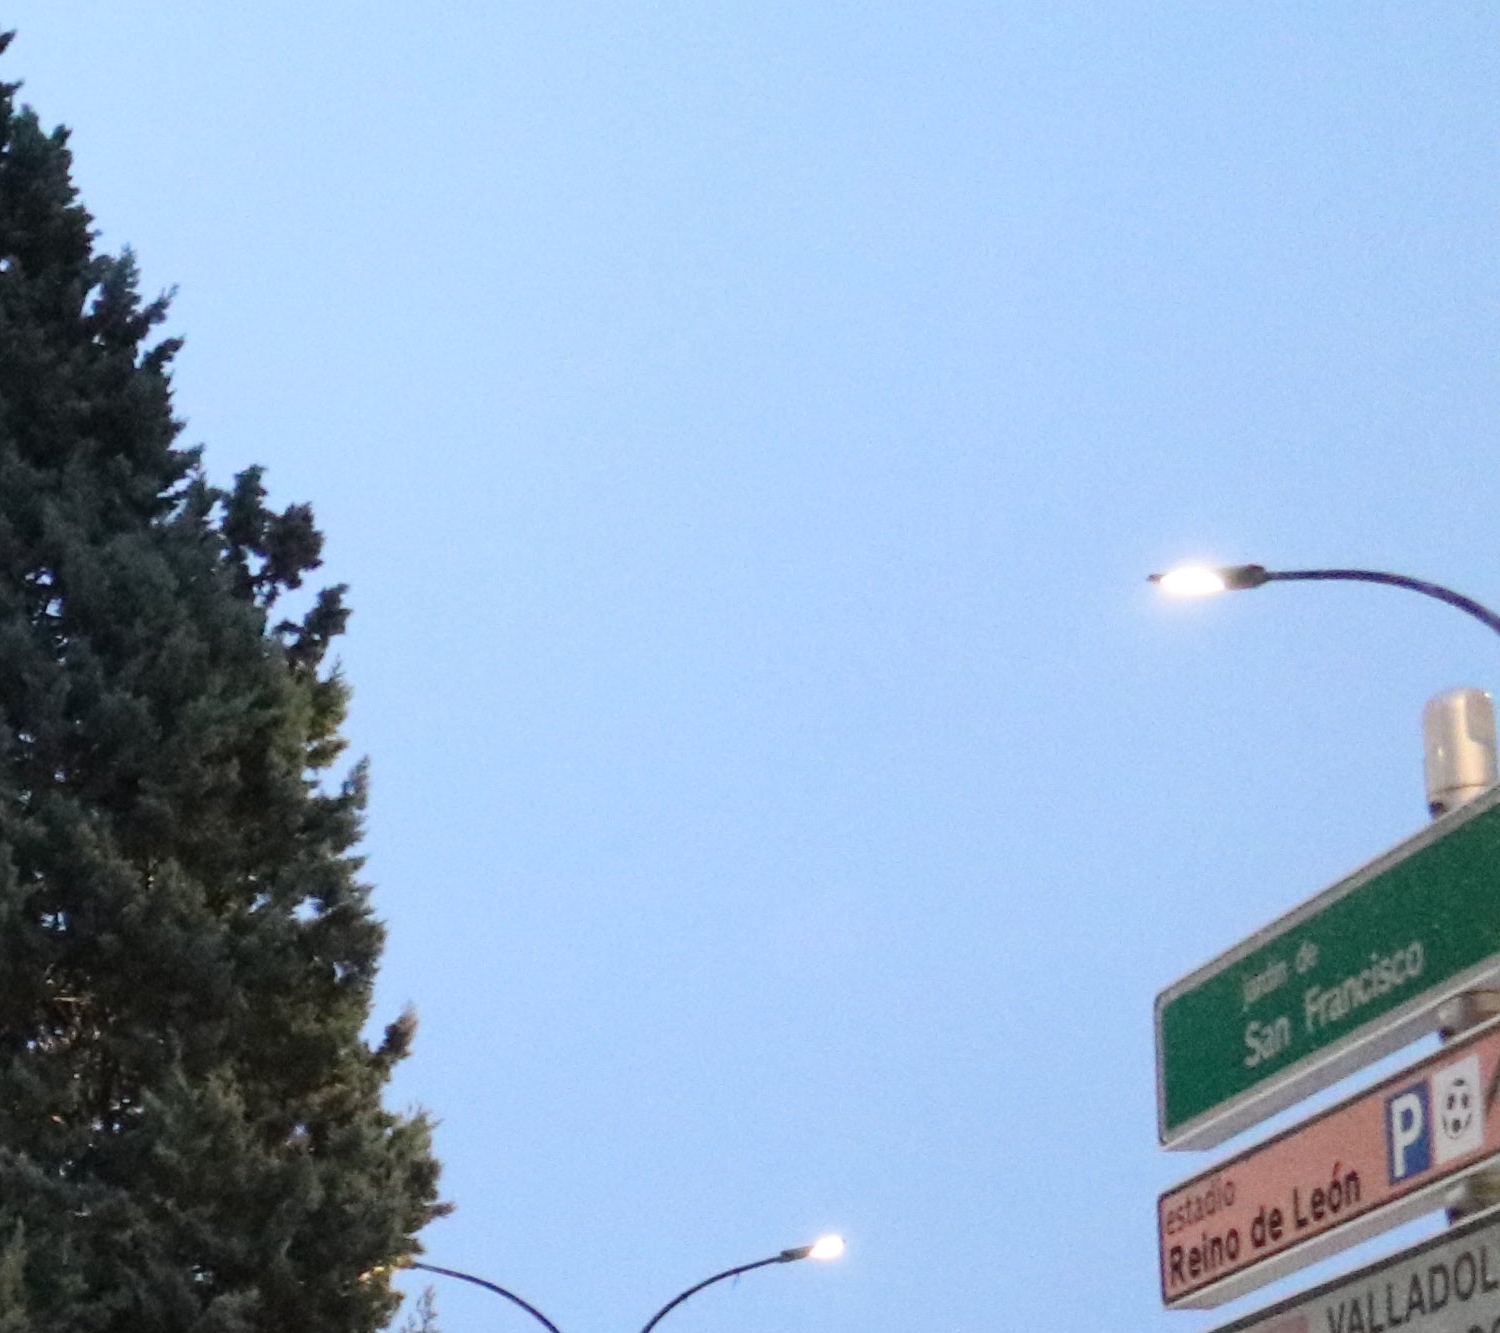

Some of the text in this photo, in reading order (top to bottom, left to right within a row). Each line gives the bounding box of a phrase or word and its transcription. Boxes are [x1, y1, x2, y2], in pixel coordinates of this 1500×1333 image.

[1244, 940, 1425, 1067] San Francisco
[1165, 1178, 1238, 1236] estadio
[1168, 1160, 1362, 1288] Reino de León
